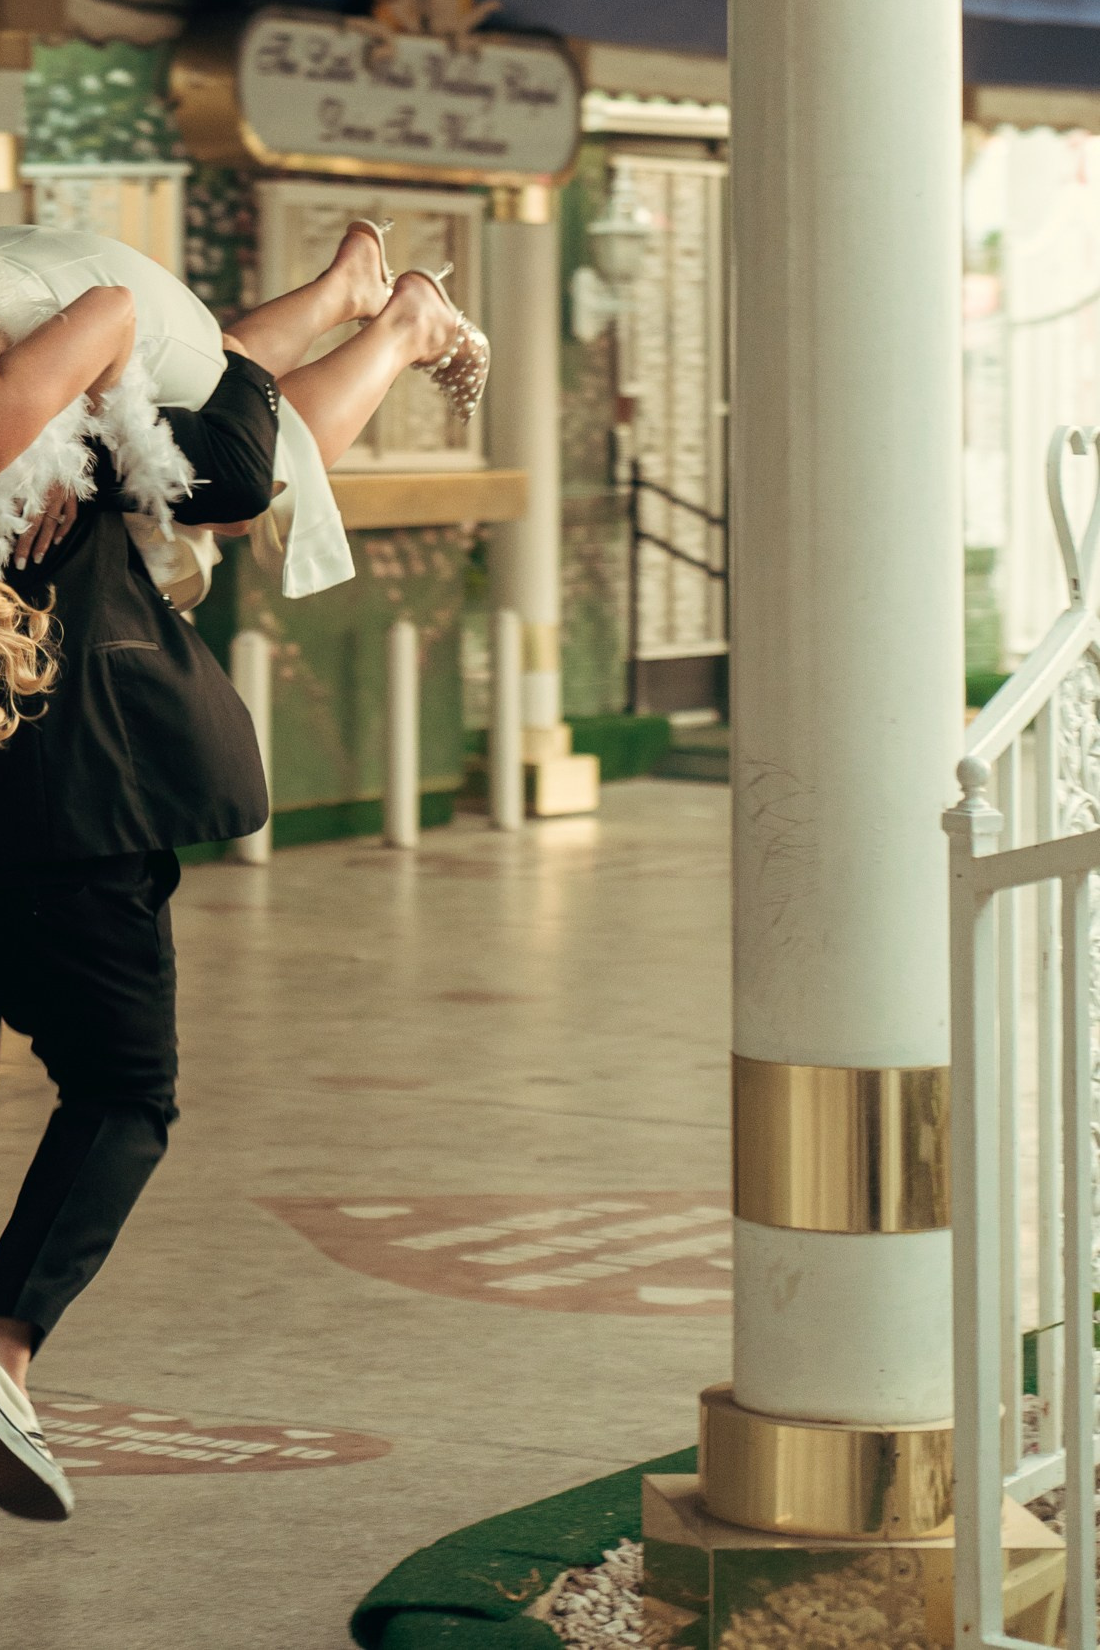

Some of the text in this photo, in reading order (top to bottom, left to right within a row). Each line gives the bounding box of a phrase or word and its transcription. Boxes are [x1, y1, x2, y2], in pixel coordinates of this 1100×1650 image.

[100, 1426, 280, 1455] belong
[277, 1446, 338, 1460] to
[105, 1440, 255, 1465] heart
